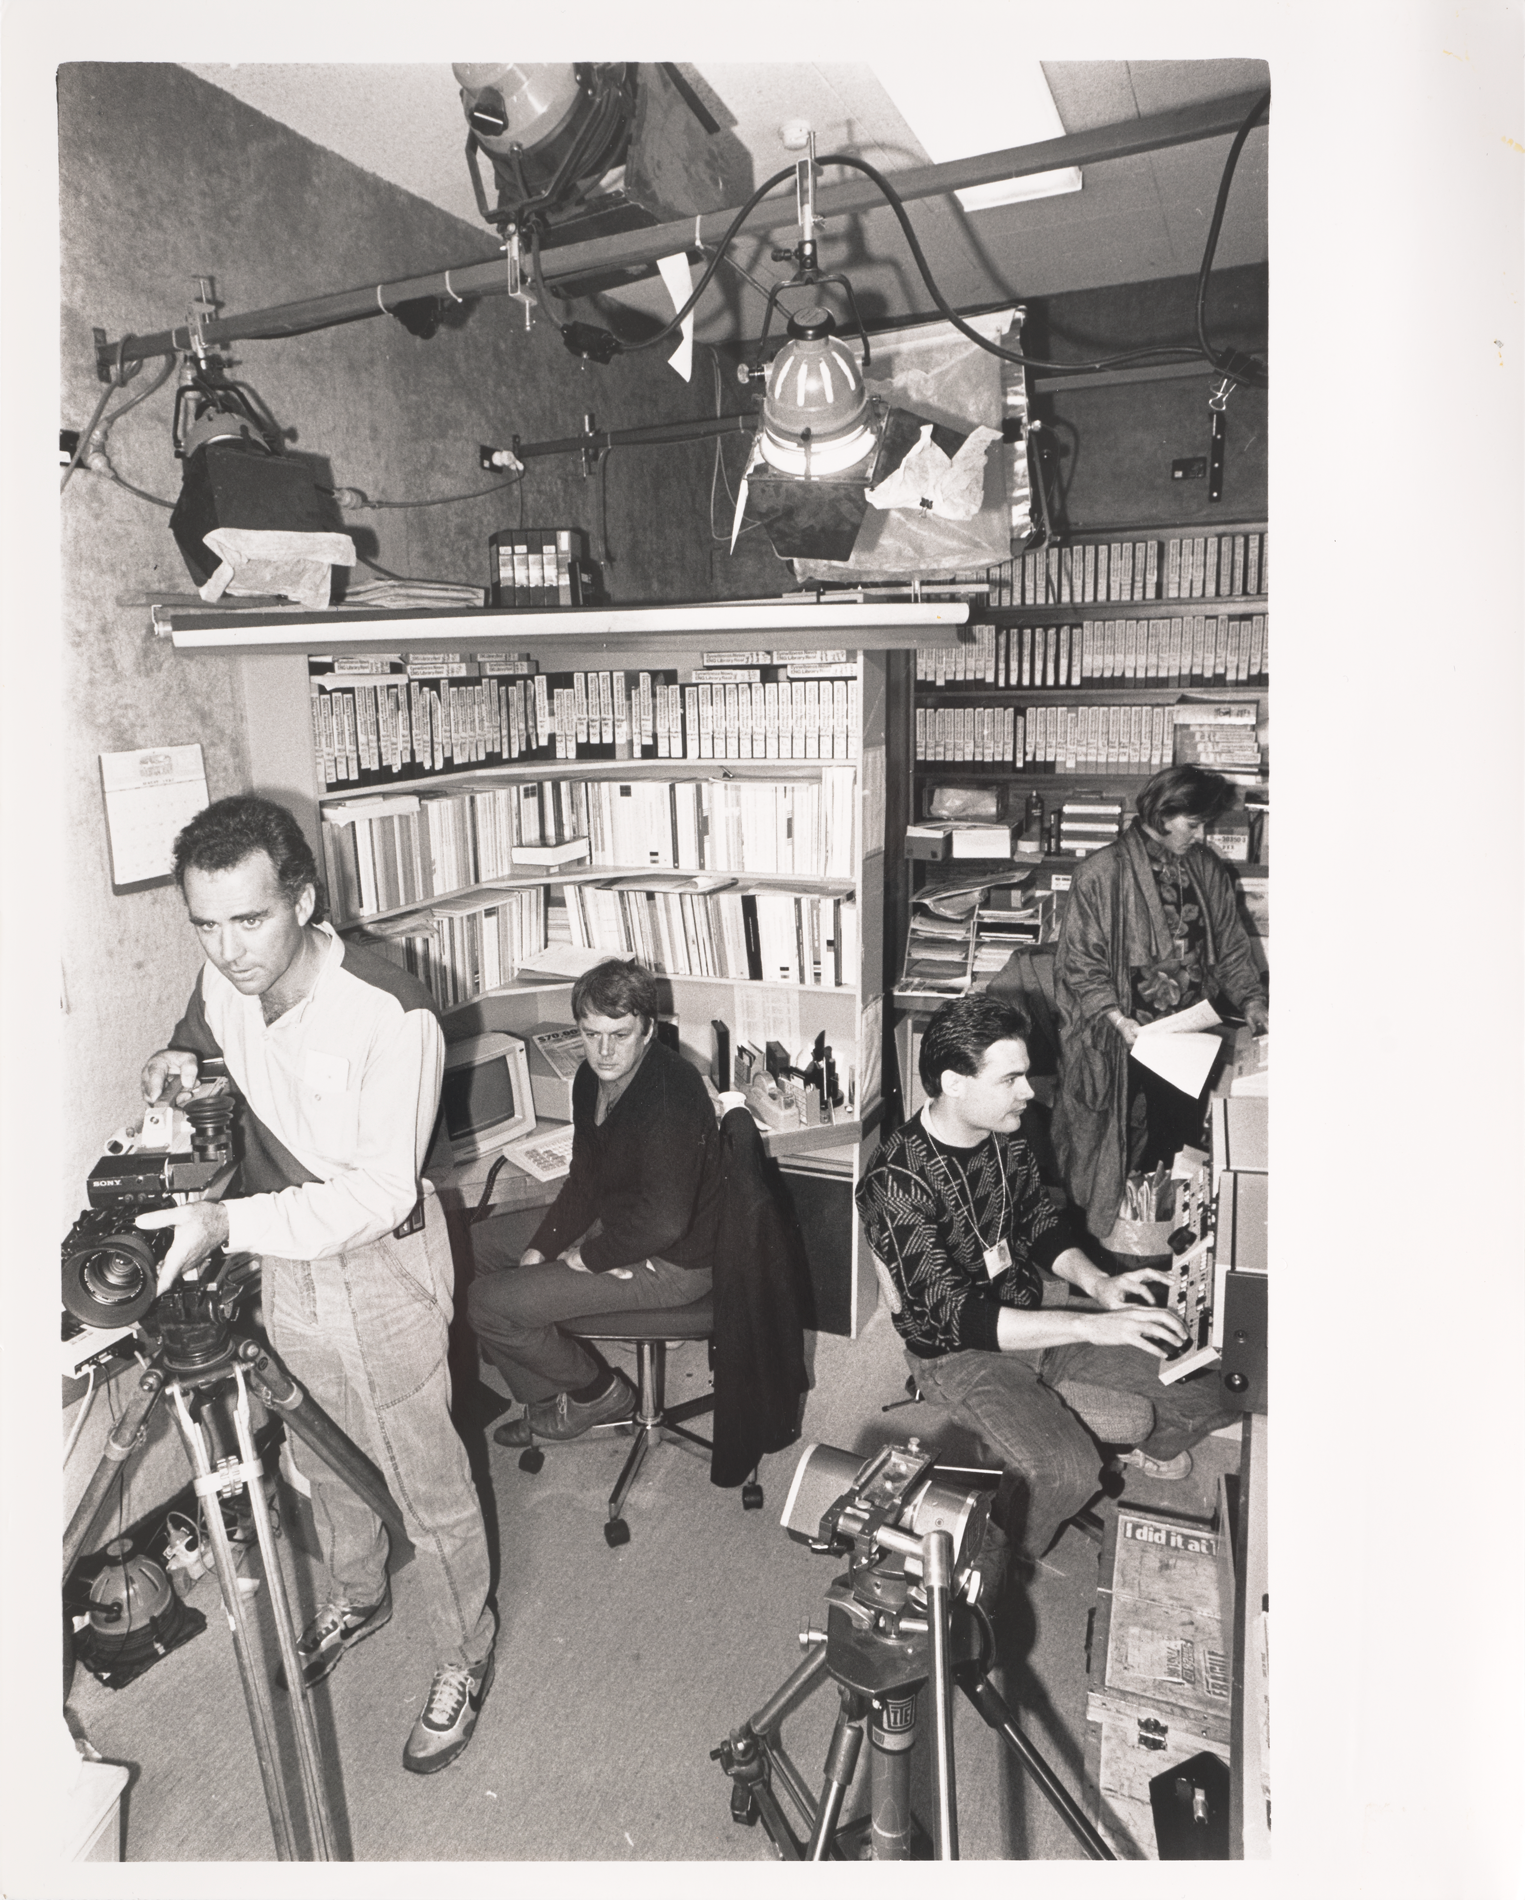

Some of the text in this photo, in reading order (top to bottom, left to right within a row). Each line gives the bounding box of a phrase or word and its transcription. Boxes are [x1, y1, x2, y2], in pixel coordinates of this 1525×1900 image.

[537, 1029, 578, 1042] $70,00
[92, 1179, 122, 1188] SONY
[1125, 1522, 1133, 1538] I
[1135, 1525, 1167, 1545] did
[1170, 1531, 1185, 1550] it
[1187, 1539, 1209, 1555] at
